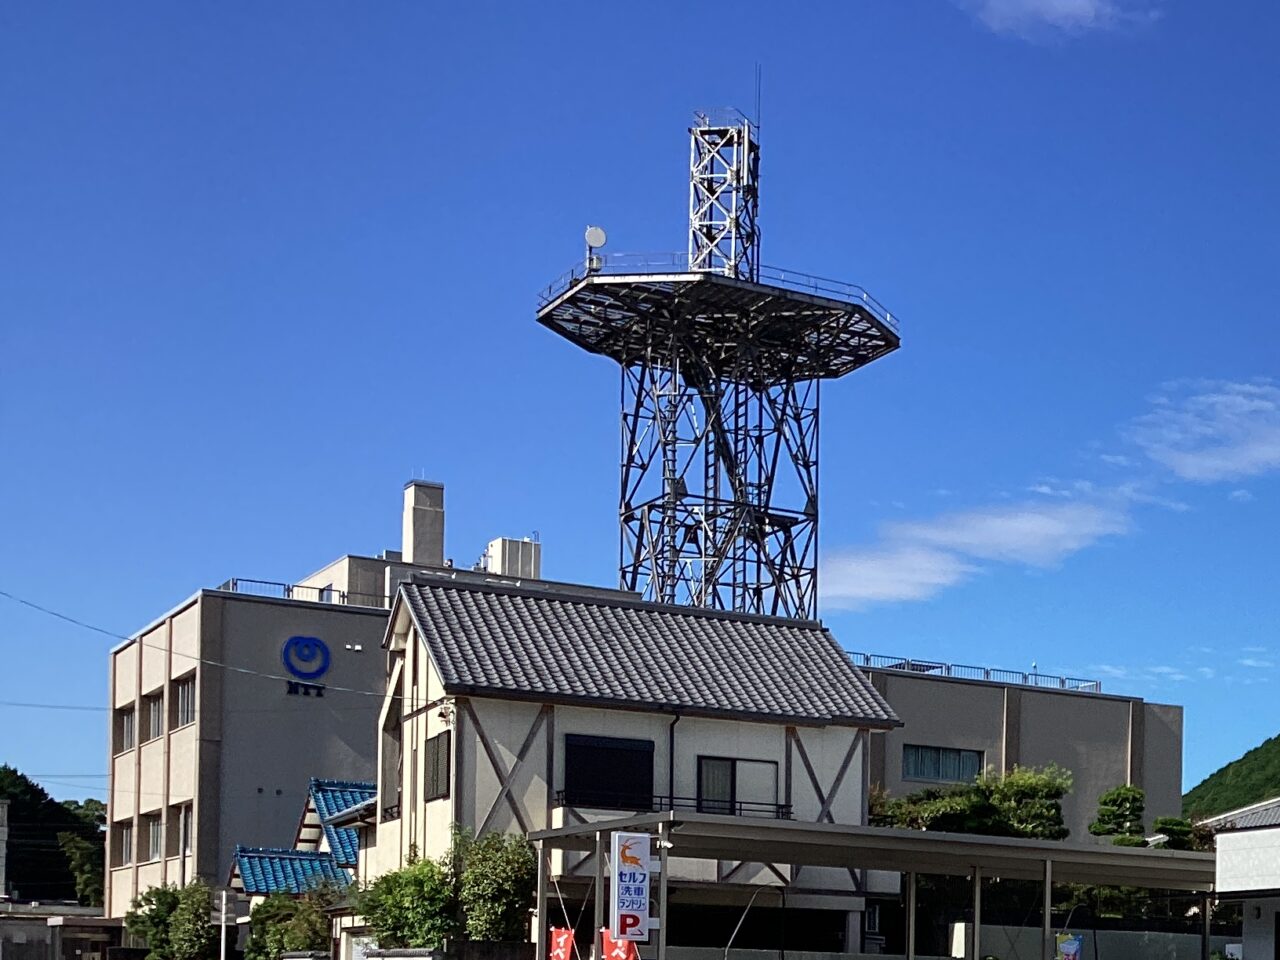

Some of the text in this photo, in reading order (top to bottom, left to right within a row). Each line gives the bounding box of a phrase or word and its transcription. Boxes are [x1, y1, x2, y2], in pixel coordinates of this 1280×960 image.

[286, 680, 326, 697] NTT
[618, 871, 647, 884] セルフ
[619, 899, 646, 909] ランドリー
[620, 914, 640, 936] P
